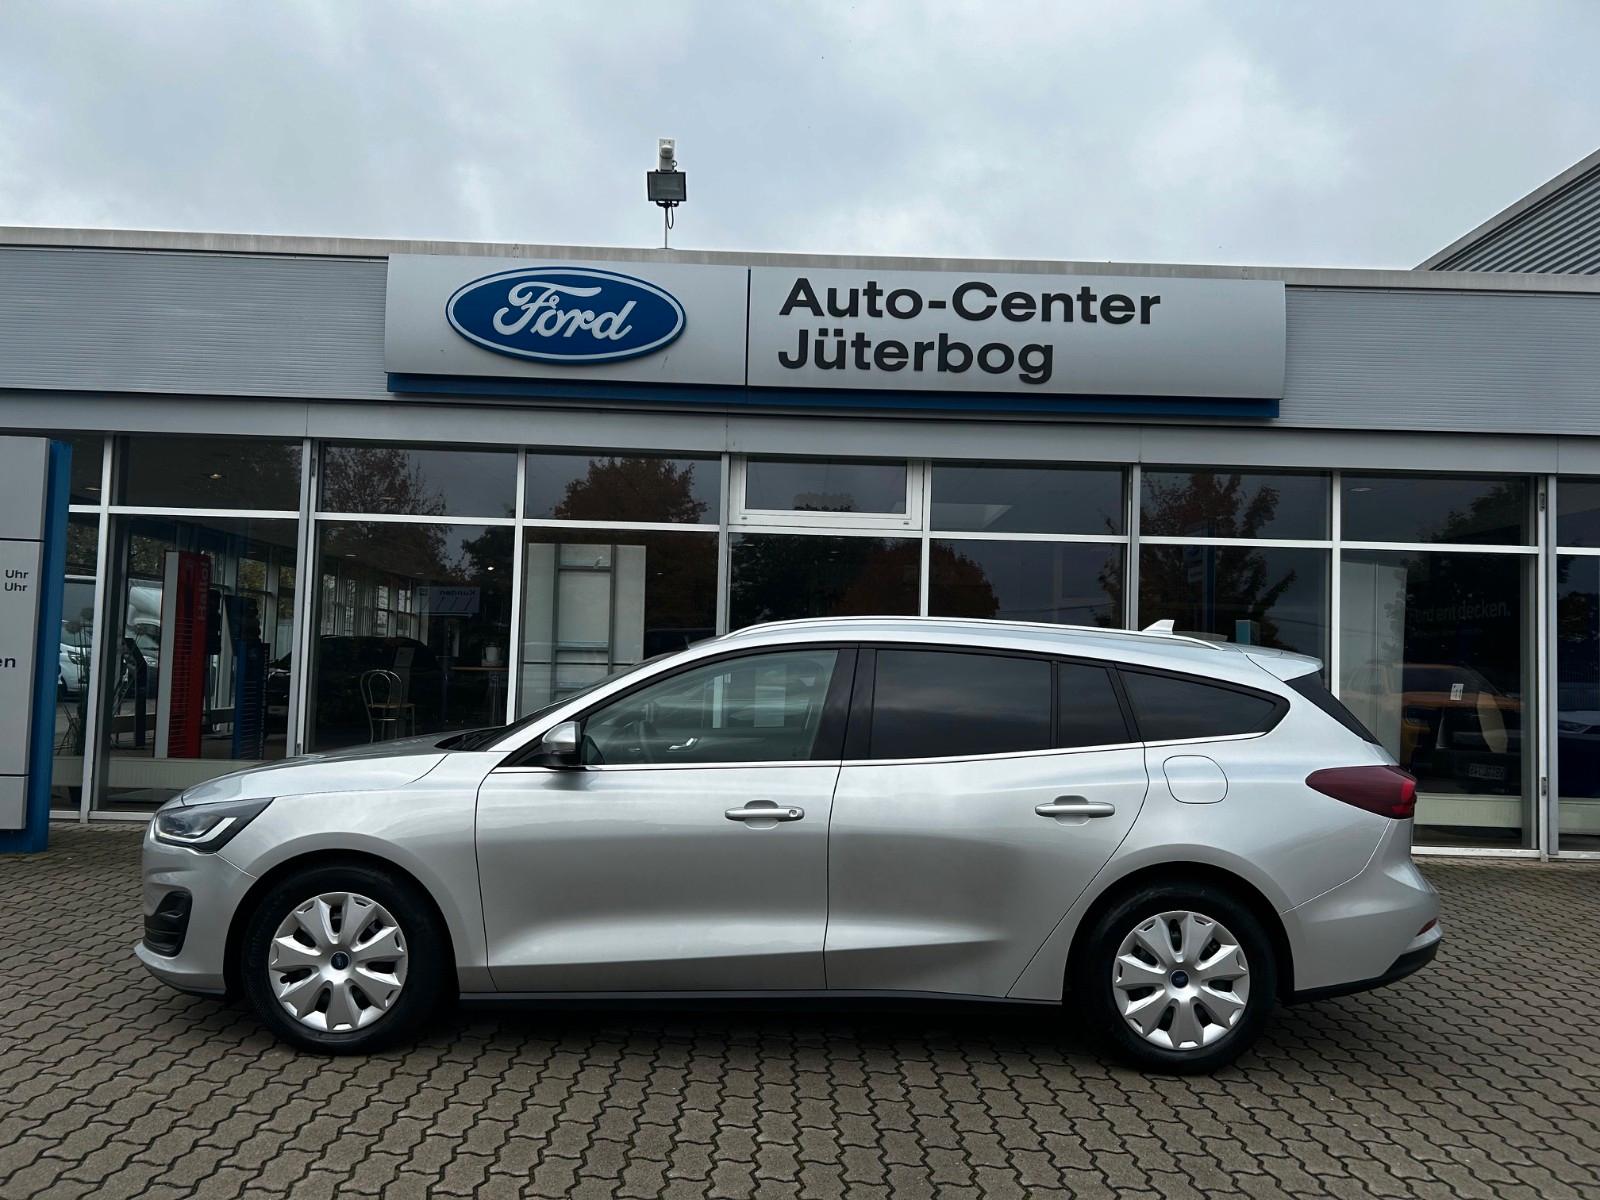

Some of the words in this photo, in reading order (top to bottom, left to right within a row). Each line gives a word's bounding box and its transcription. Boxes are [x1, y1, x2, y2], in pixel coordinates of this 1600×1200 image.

[492, 281, 637, 341] Ford
[779, 277, 1162, 325] Auto-Center
[777, 327, 1054, 386] Jüterbog
[4, 582, 28, 592] Uhr
[5, 569, 29, 579] Uhr
